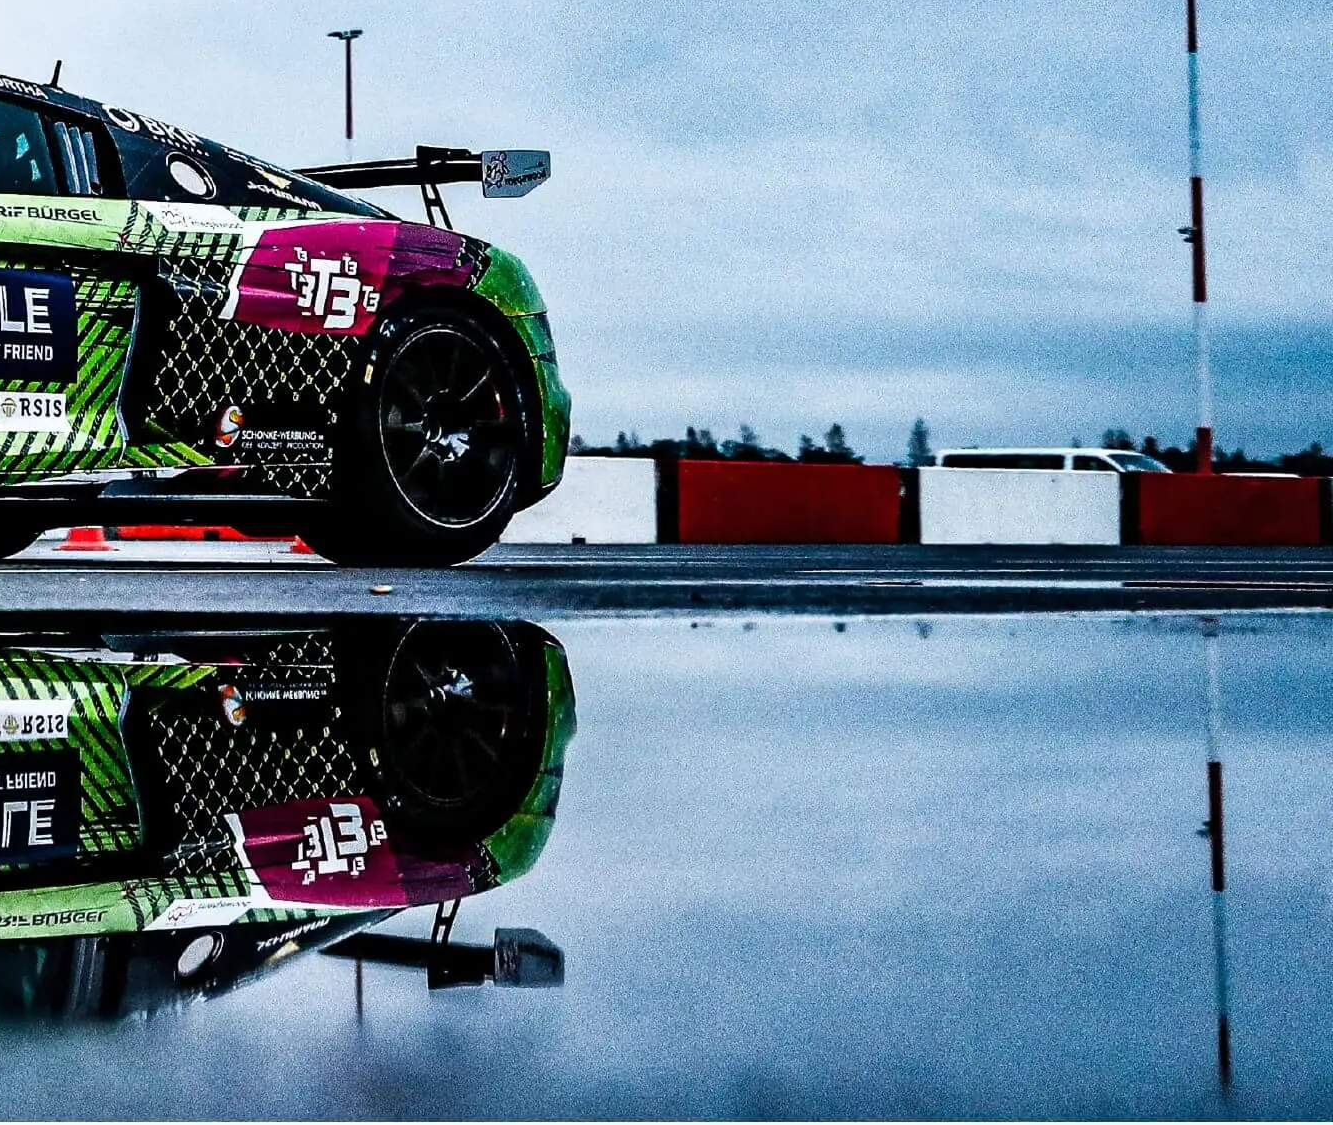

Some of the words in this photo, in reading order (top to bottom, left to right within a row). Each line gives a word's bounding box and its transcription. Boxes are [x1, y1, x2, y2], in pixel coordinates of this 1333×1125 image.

[342, 255, 358, 276] T3
[284, 262, 316, 308] T3
[310, 258, 362, 329] T3
[362, 285, 381, 312] T3
[3, 343, 54, 362] FRIEND
